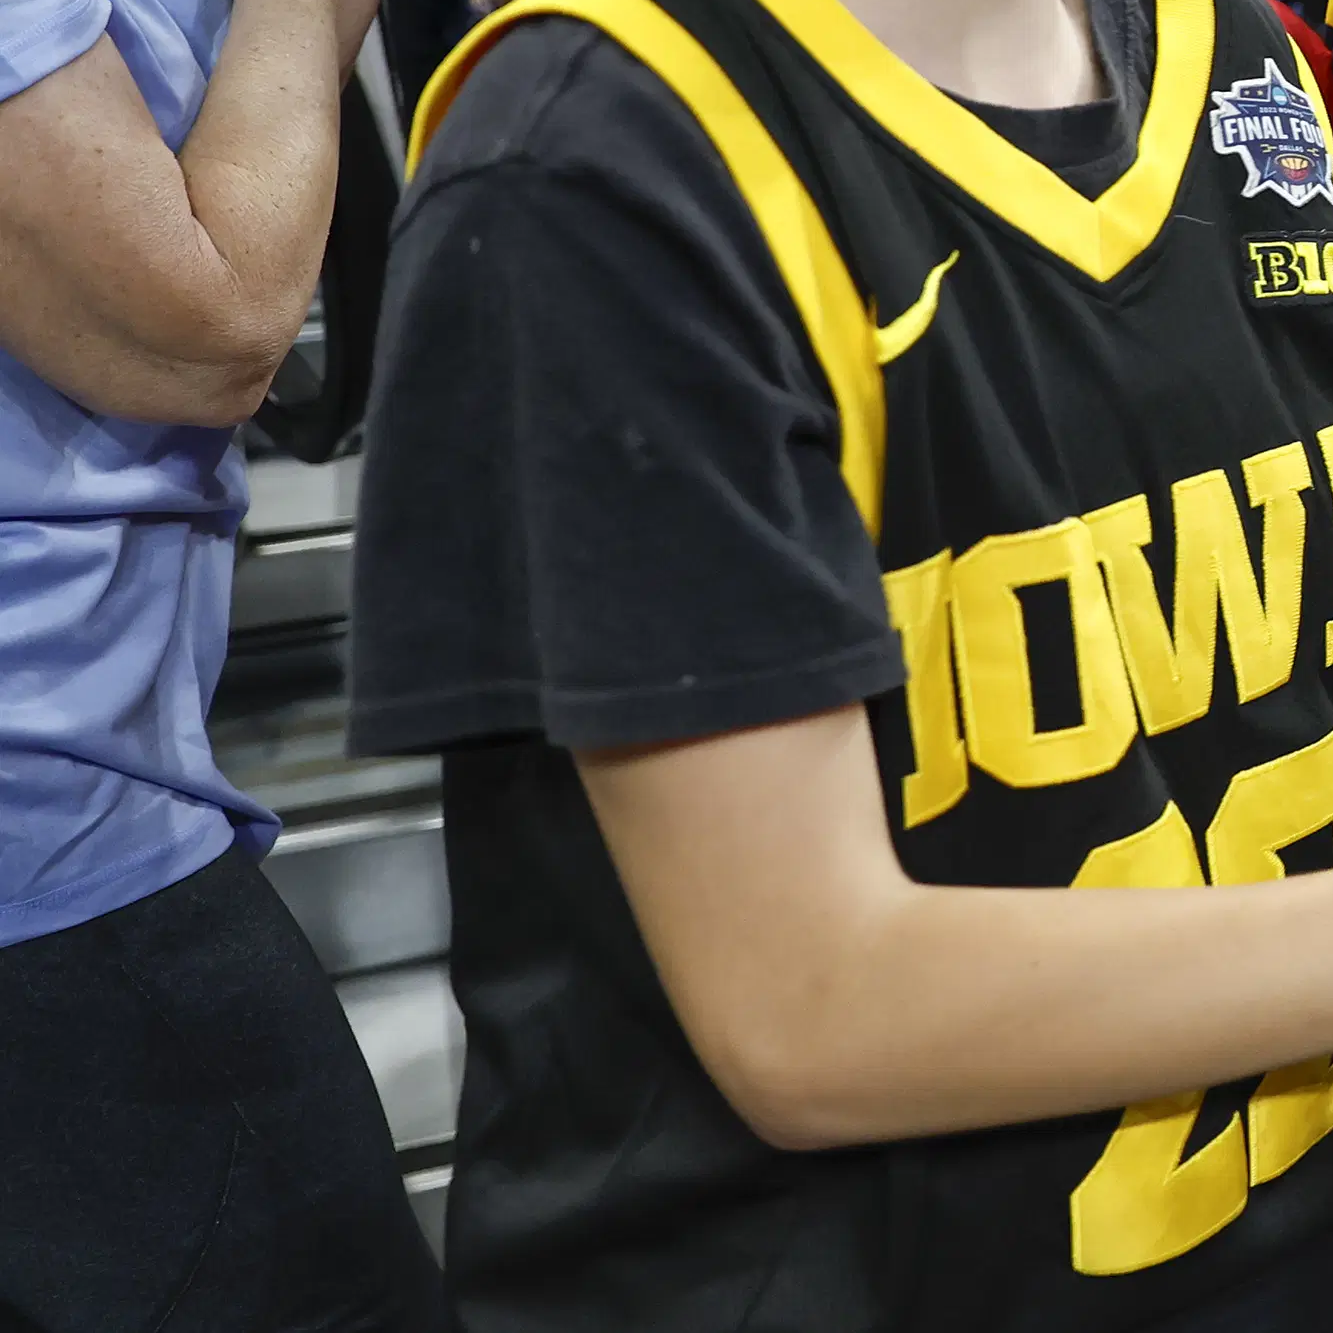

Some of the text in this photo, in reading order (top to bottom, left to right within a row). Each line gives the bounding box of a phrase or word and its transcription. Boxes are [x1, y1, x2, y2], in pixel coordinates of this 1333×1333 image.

[1223, 115, 1325, 148] FINAL FOU
[1278, 144, 1304, 153] DALLAS
